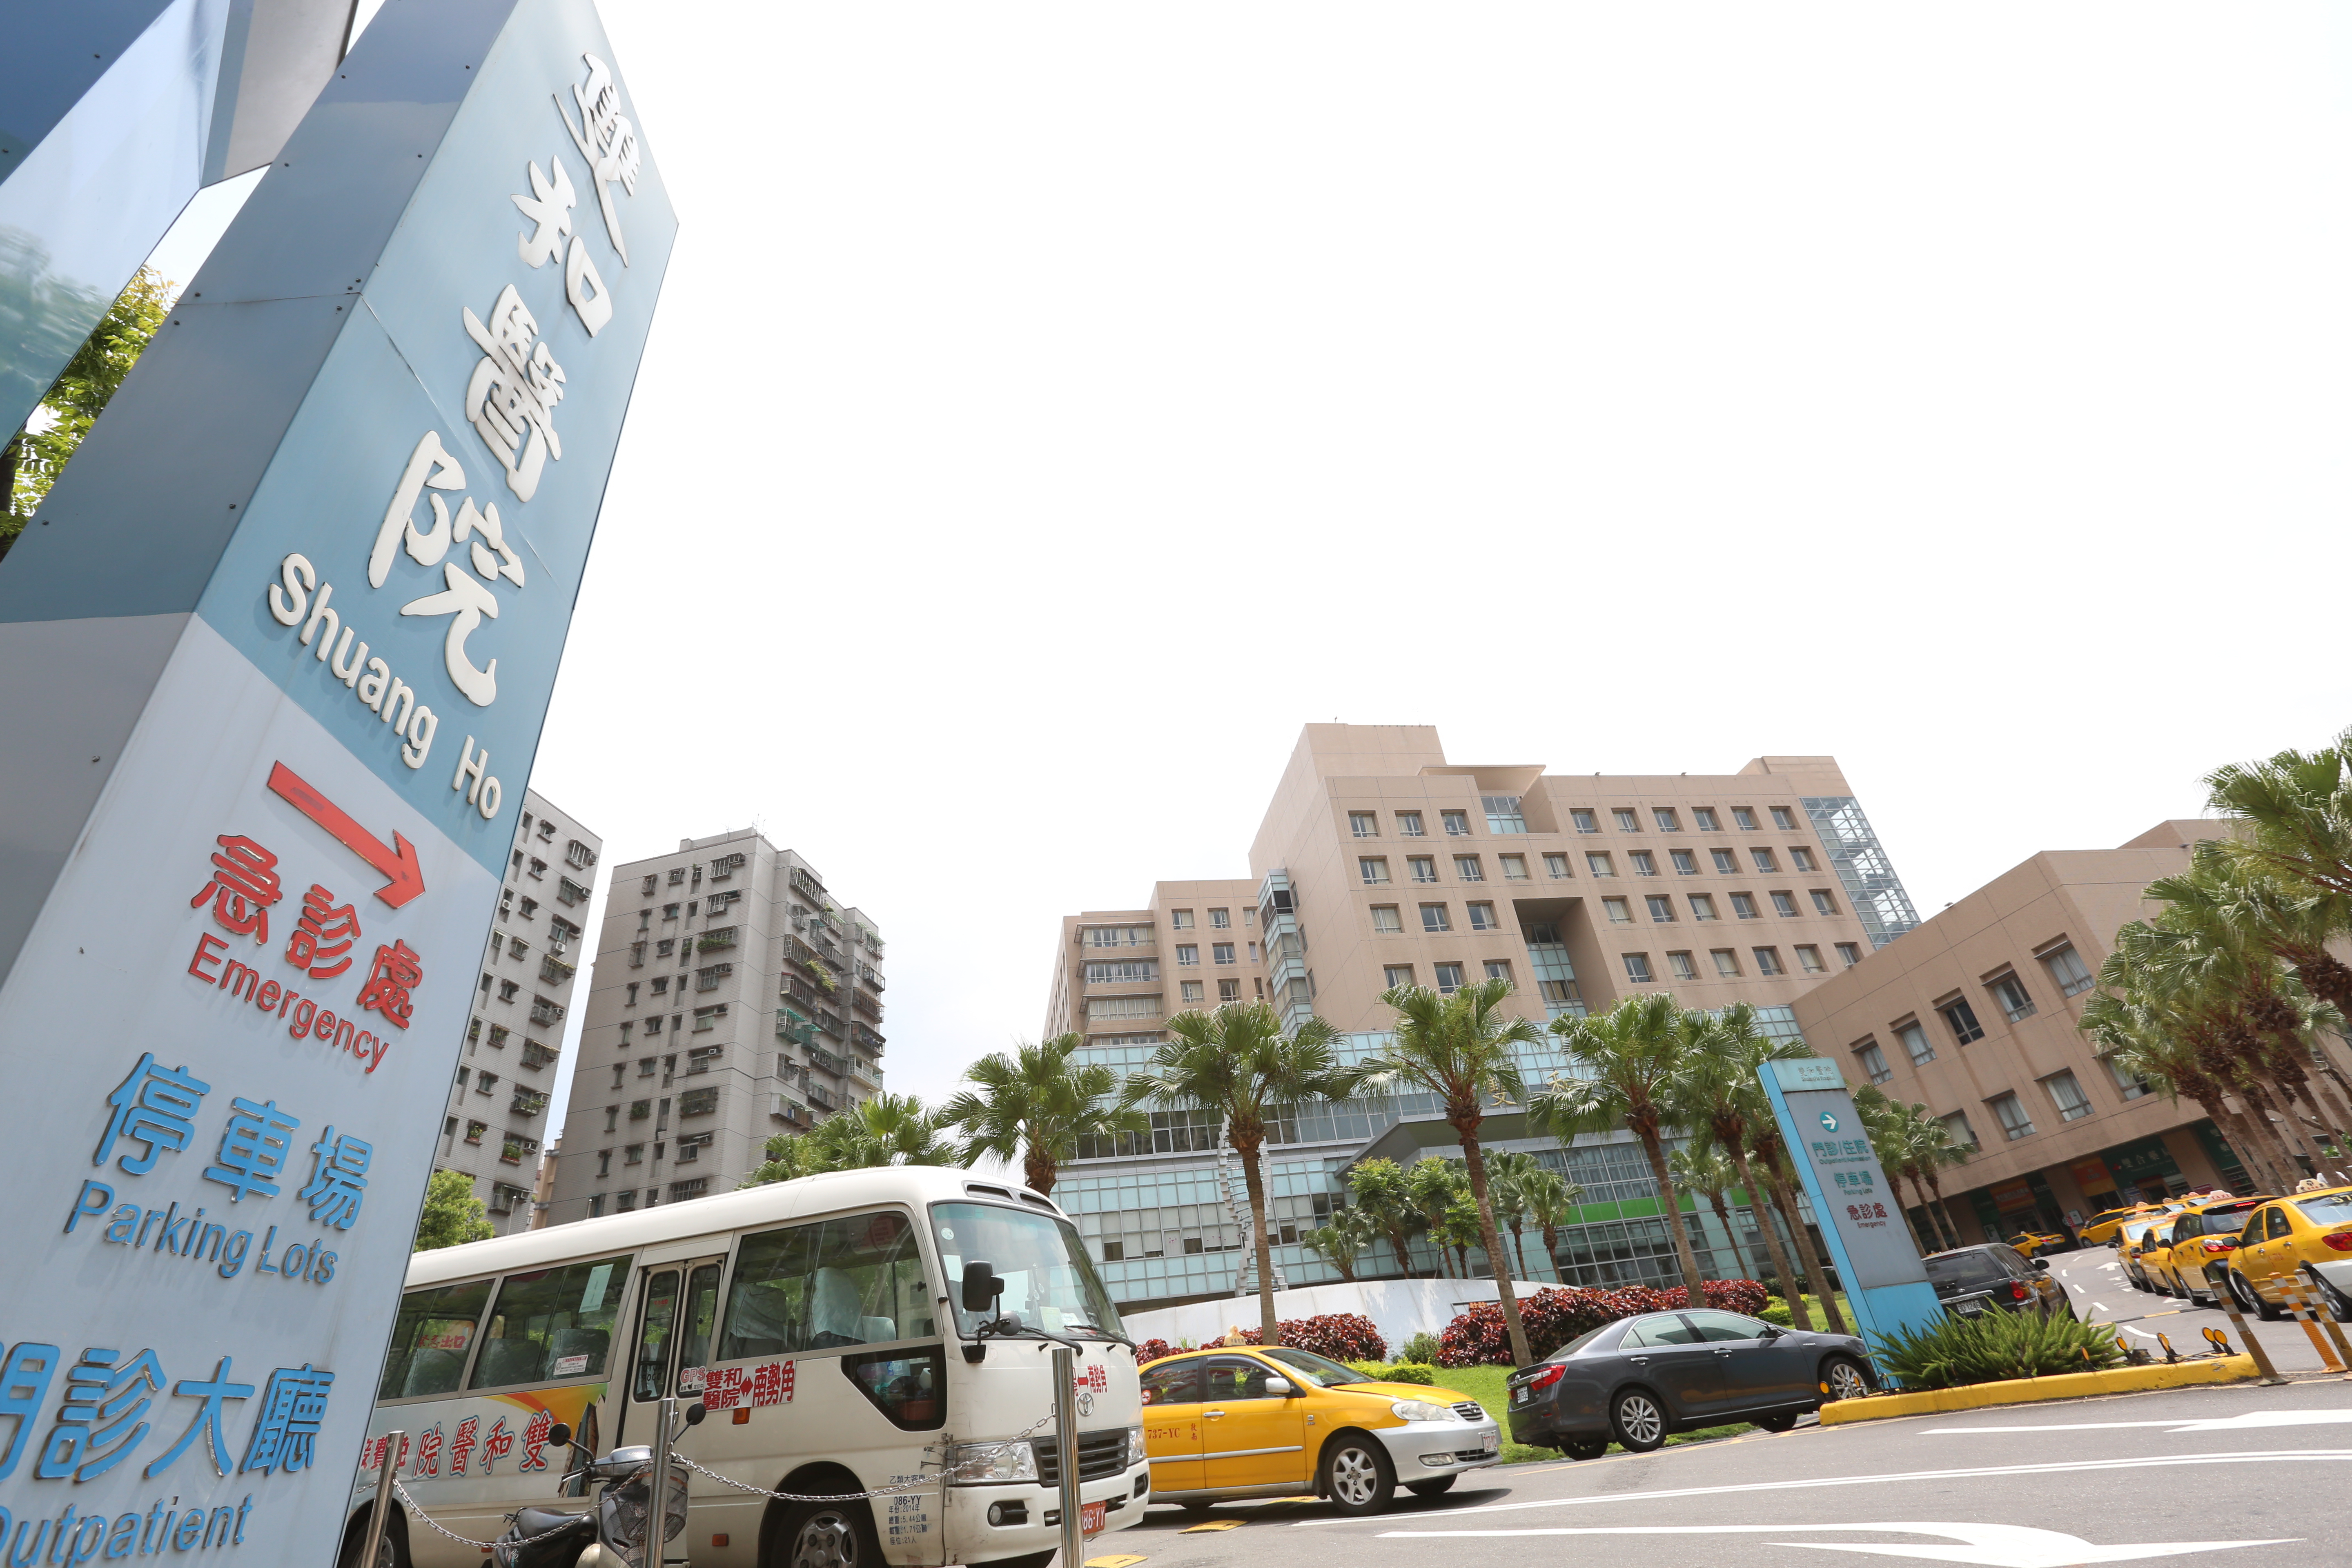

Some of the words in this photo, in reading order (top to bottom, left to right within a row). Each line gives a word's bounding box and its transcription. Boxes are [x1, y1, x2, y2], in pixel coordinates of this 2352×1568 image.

[368, 52, 639, 706] 雙和醫院
[270, 553, 439, 769] Shuang
[452, 735, 501, 819] Ho
[191, 835, 422, 1030] 急診處
[187, 932, 389, 1073] Emergency
[92, 1052, 373, 1230] 停車場
[1834, 1170, 1873, 1188] 停車場
[1846, 1202, 1888, 1221] 急診處
[2330, 1194, 2352, 1203] 57
[63, 1180, 254, 1278] Parking
[258, 1226, 339, 1284] Lots
[681, 1367, 706, 1383] GPS
[704, 1368, 743, 1391] 雙和
[753, 1360, 795, 1407] 南勢角
[703, 1388, 741, 1410] 醫院
[1148, 1428, 1180, 1439] 737-YC
[894, 1495, 921, 1506] 086-YY
[0, 1493, 253, 1568] utpatient
